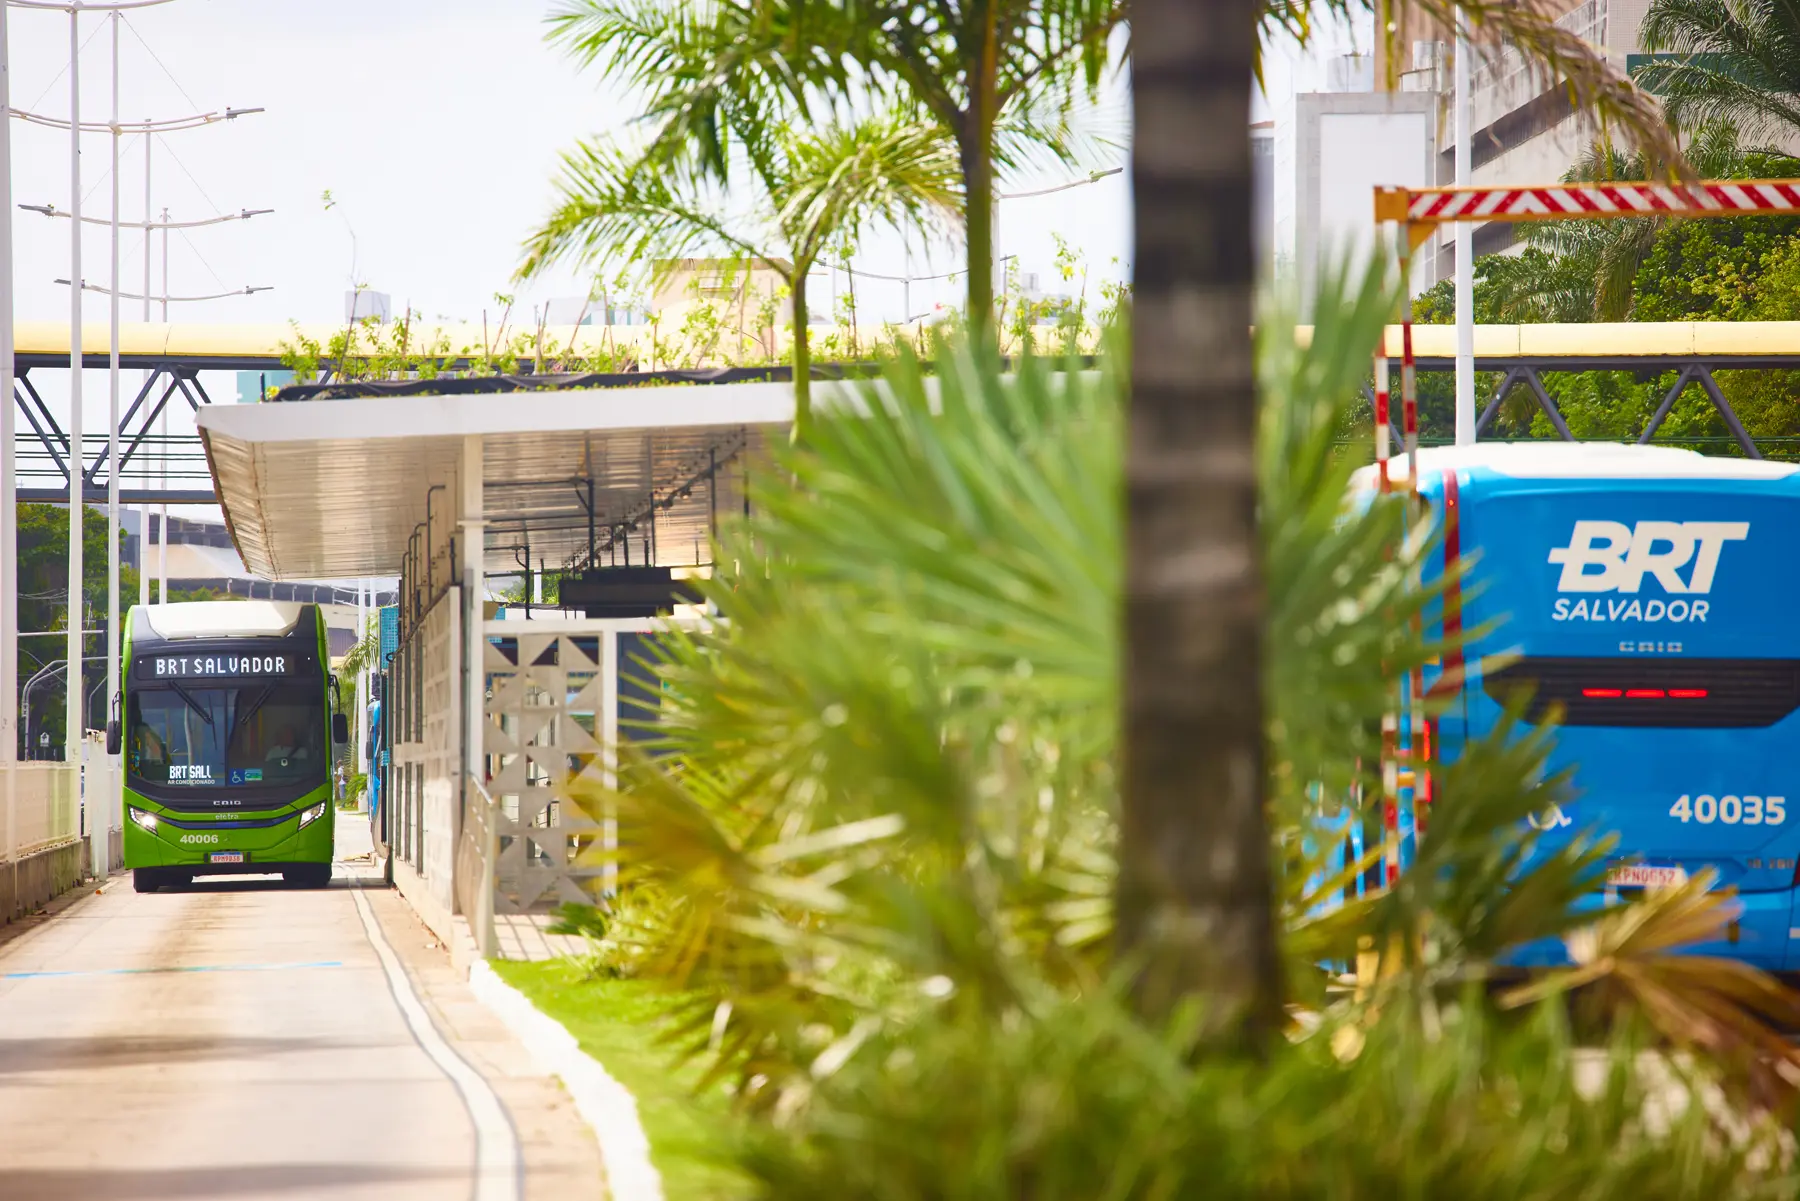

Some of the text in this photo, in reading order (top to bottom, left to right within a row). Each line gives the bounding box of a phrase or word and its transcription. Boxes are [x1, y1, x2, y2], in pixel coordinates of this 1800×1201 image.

[1548, 520, 1750, 594] BRT
[1553, 599, 1710, 622] SALVADOR
[1619, 641, 1683, 652] CAIO
[156, 657, 285, 675] BRT SALVADOR
[169, 765, 187, 779] BRT
[1669, 795, 1786, 824] 40035
[180, 834, 219, 844] 40006
